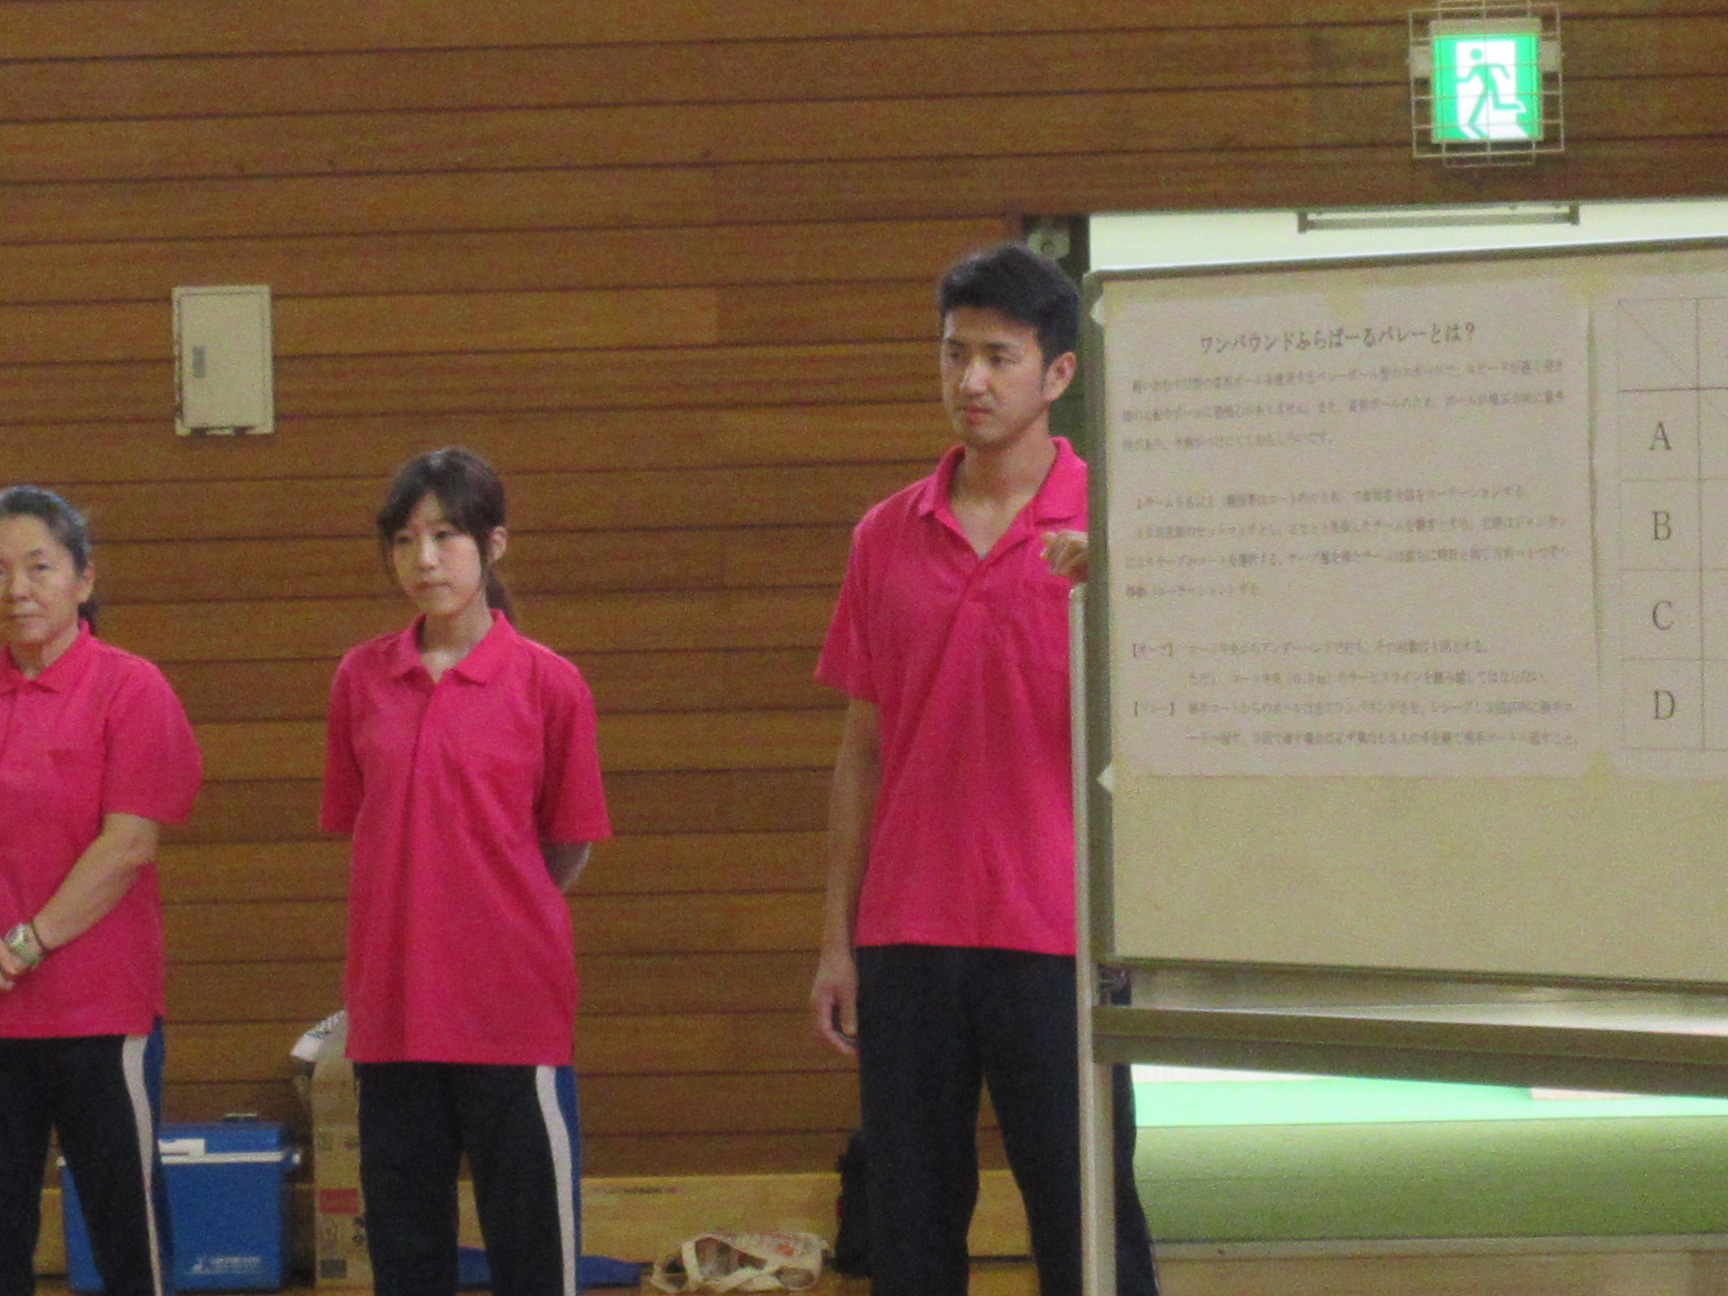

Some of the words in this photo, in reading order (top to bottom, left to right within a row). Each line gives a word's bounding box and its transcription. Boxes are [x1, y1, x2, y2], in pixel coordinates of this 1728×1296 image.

[1649, 421, 1673, 452] A
[1652, 511, 1673, 542] B
[1652, 600, 1674, 632] C
[1653, 690, 1677, 721] D
